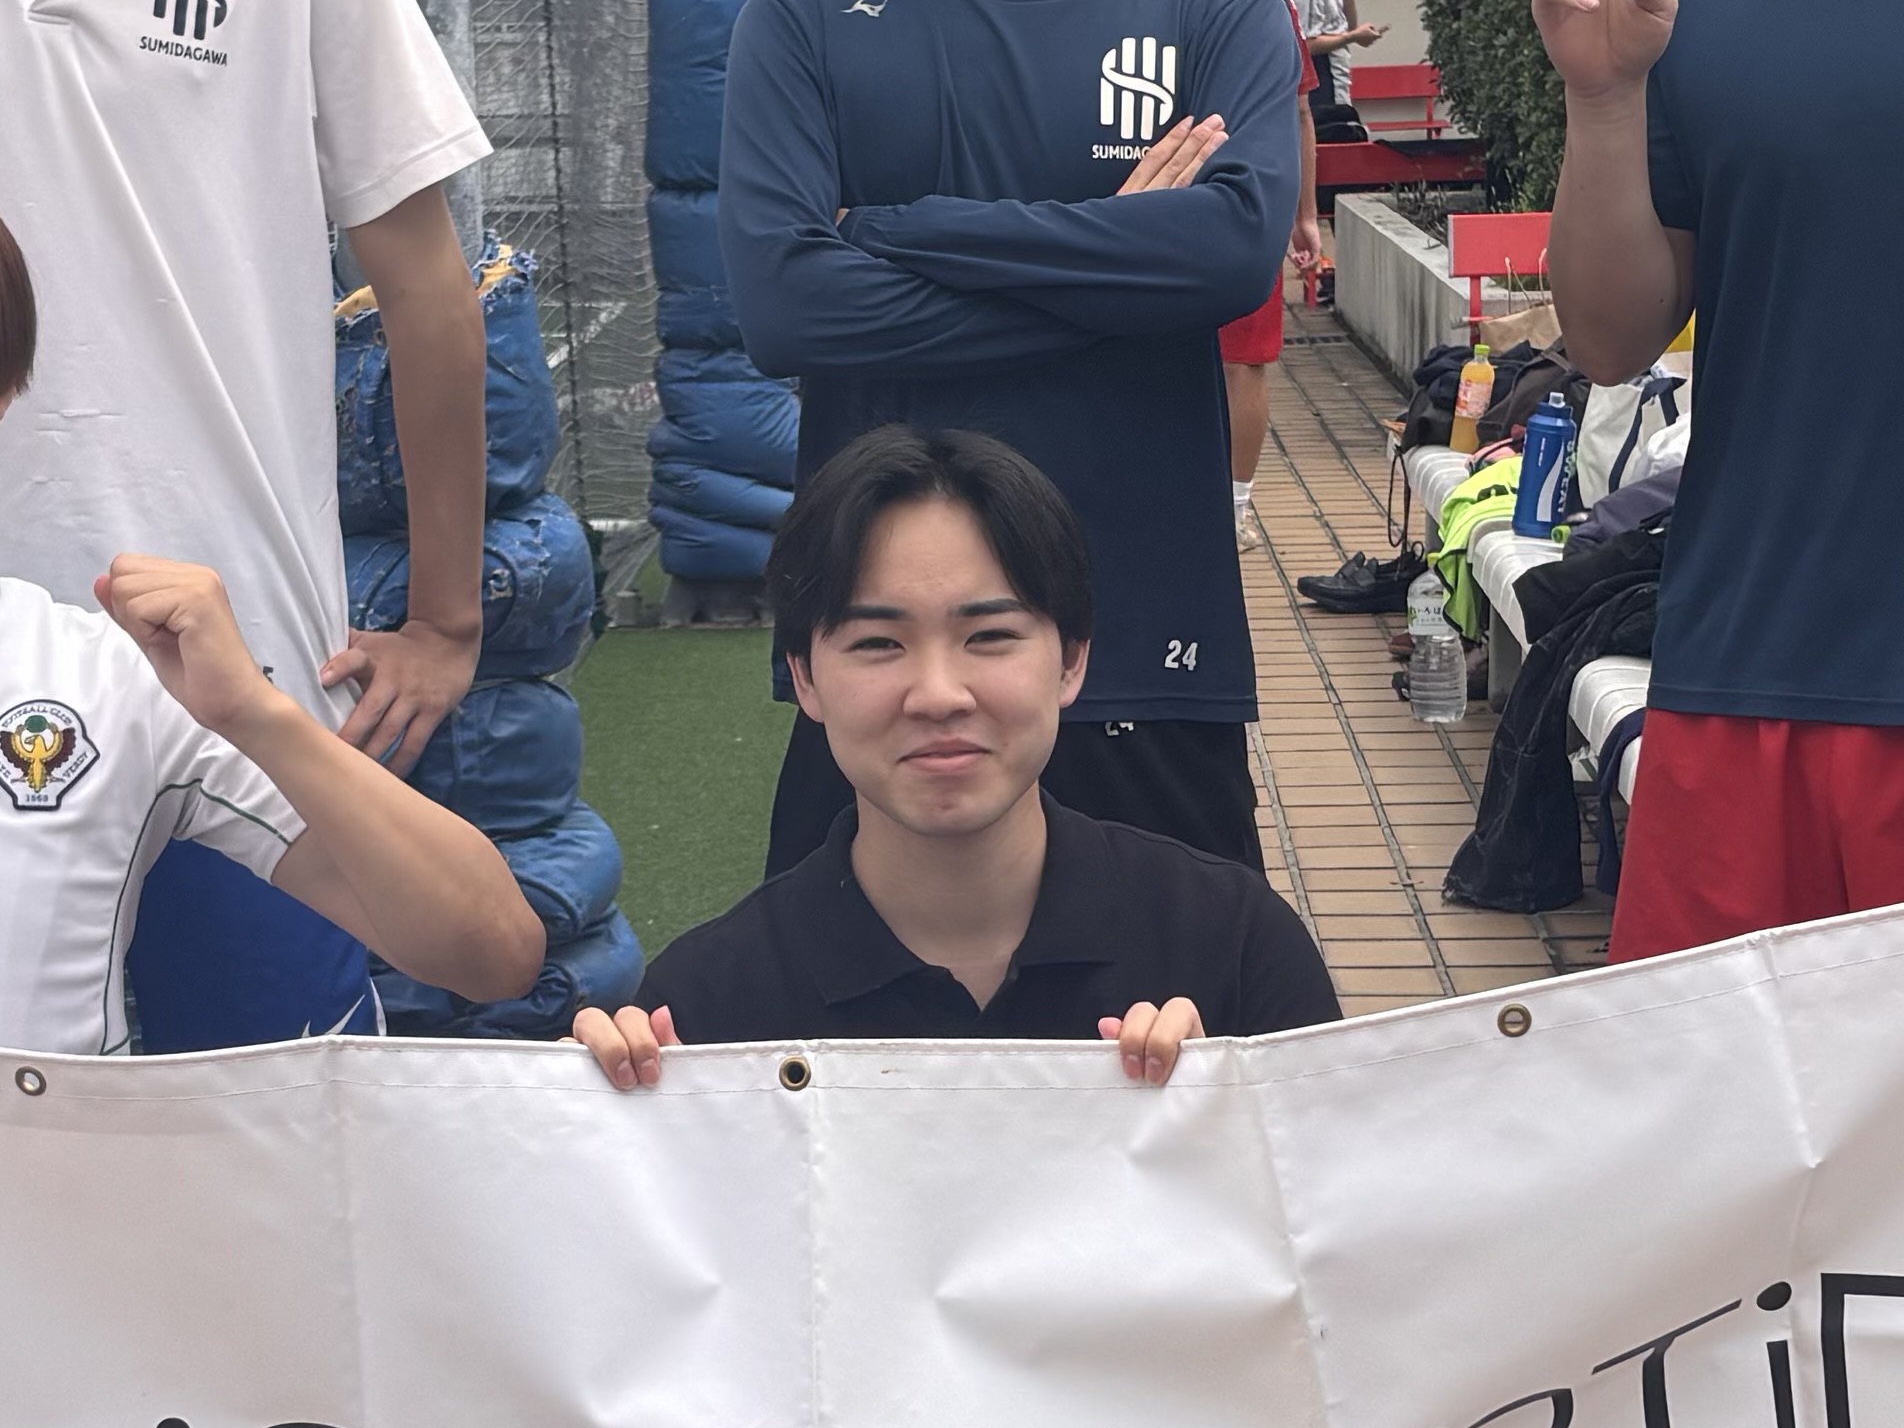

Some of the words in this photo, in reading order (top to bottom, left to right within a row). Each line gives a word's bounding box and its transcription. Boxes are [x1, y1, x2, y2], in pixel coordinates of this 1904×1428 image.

[139, 36, 228, 67] SUMIDAGAWA
[1164, 639, 1198, 671] 24
[62, 751, 89, 778] VERDY
